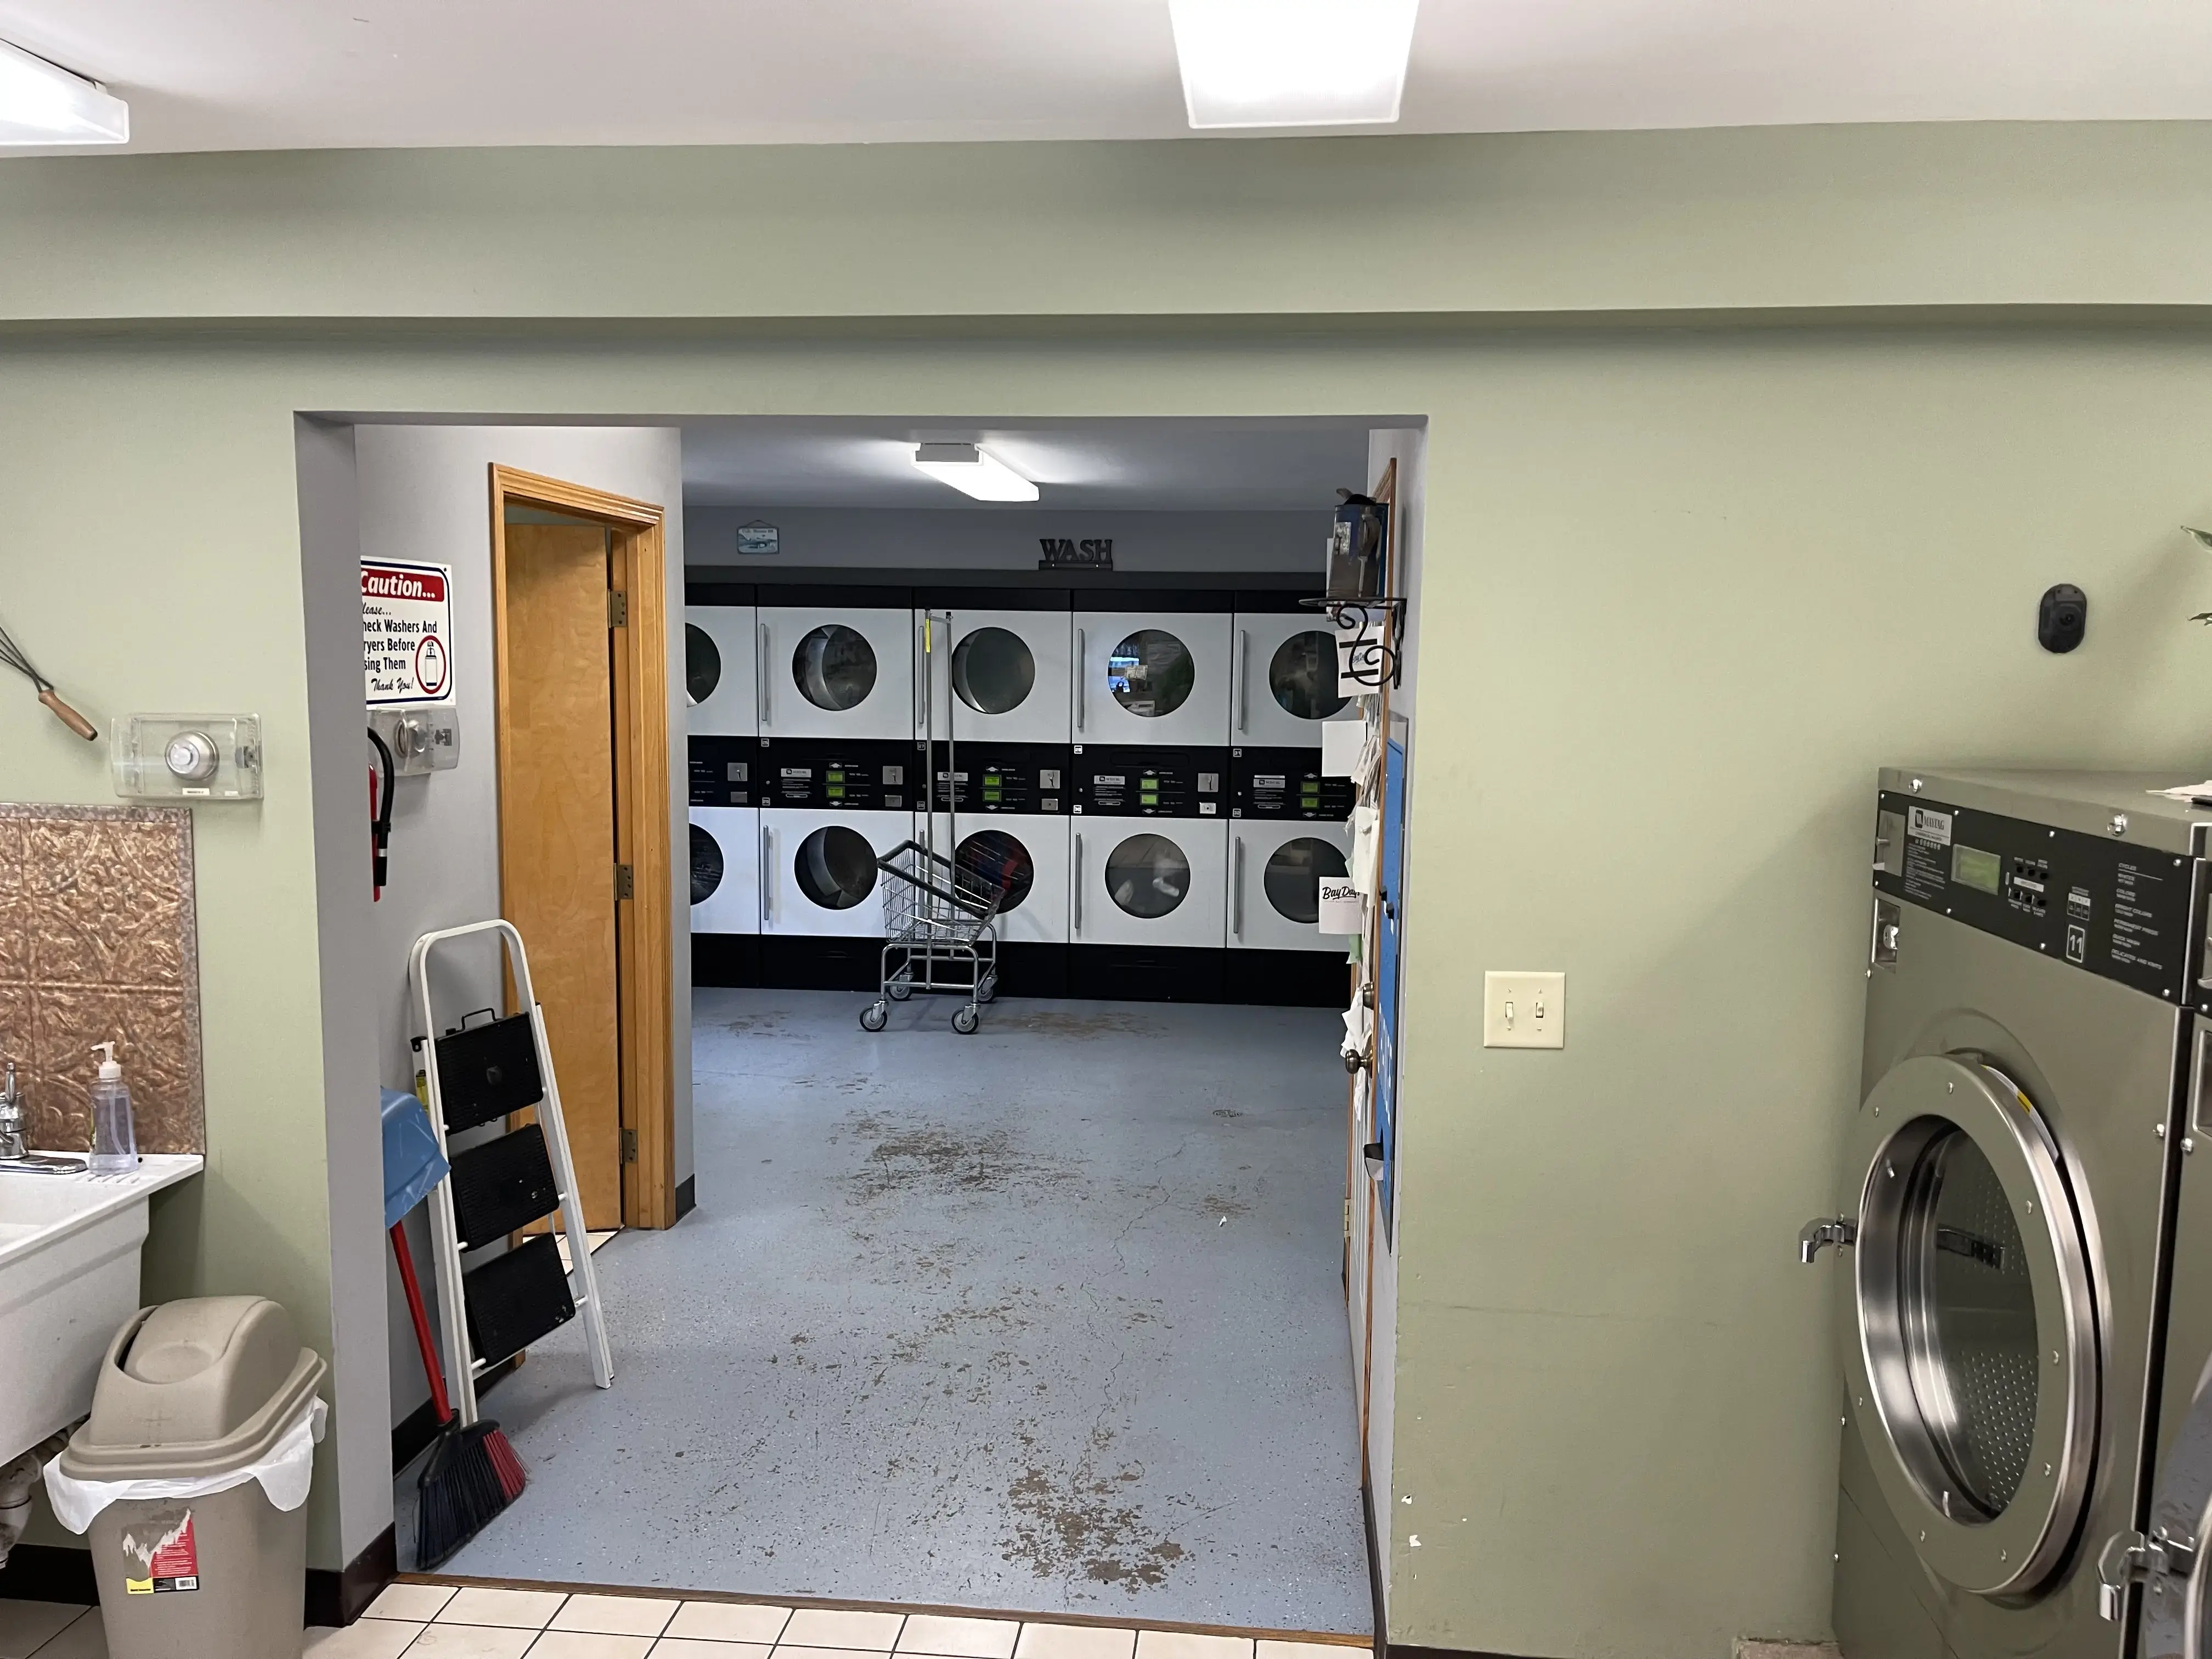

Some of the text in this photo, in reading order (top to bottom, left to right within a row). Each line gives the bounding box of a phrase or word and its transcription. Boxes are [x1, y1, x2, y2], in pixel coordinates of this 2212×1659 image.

[1039, 538, 1113, 561] WASH
[361, 570, 436, 598] Caution...
[362, 602, 391, 615] lease...
[384, 619, 420, 633] Washers
[422, 620, 437, 633] And
[363, 638, 415, 654] ryers Before
[364, 657, 406, 673] sing Them
[371, 676, 414, 694] Thank You!
[1322, 887, 1341, 900] Bay
[2069, 934, 2083, 954] 11
